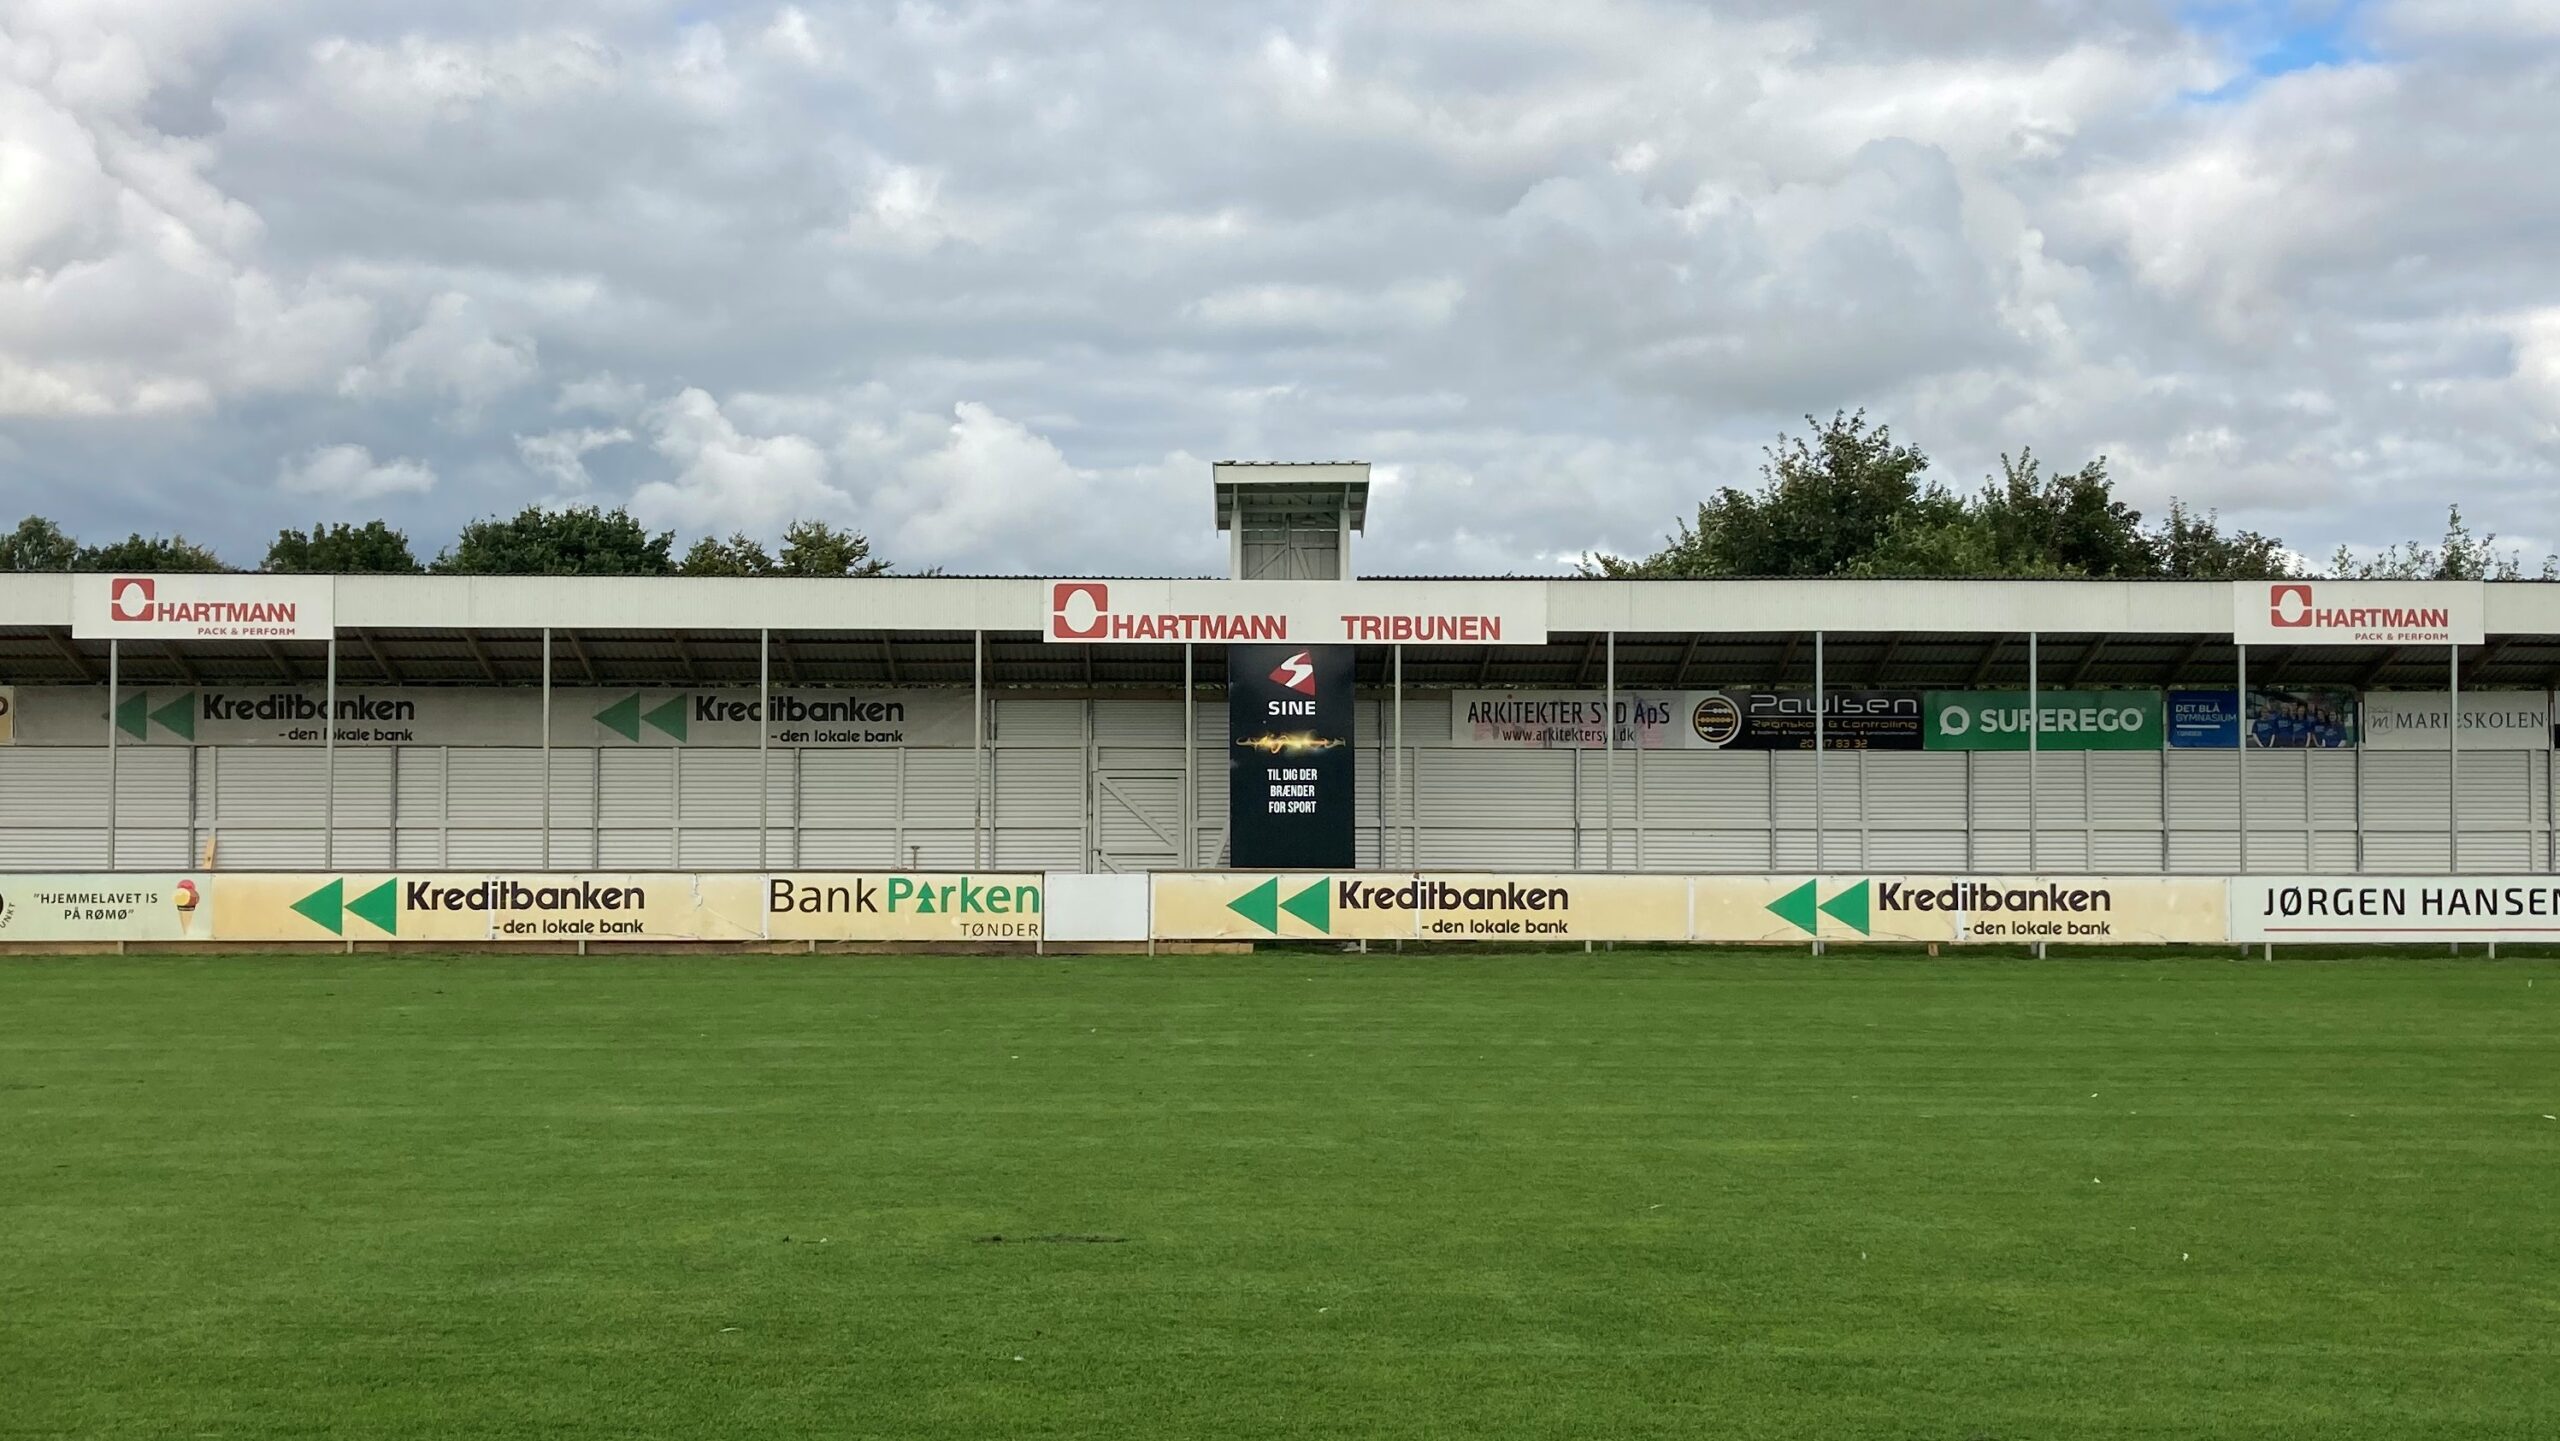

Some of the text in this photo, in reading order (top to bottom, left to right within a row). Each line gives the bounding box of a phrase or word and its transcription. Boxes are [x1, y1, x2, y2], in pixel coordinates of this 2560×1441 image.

[157, 602, 296, 623] HARTMANN
[2315, 608, 2449, 628] HARTMANN
[198, 627, 296, 636] PACK & PERFORM
[1112, 614, 1501, 641] HARTMANN TRIBUNEN
[2355, 632, 2449, 641] PACK & PERFORM
[203, 693, 415, 720] Kreditbanken
[1268, 700, 1316, 716] SINE
[1750, 694, 1918, 714] Paulsen
[2175, 701, 2221, 713] DET BLÅ
[1467, 700, 1583, 724] ARKITEKTER
[1633, 701, 1670, 730] ApS
[1979, 707, 2144, 733] SUPEREGO
[2175, 713, 2237, 722] GYMNASIUM
[2395, 711, 2544, 729] MARISKOLEN
[1751, 719, 1817, 729] Regnska
[1841, 720, 1918, 730] Controlling
[374, 727, 413, 741] bank
[814, 729, 860, 743] lokale
[864, 729, 903, 743] bank
[1835, 738, 1851, 749] 83
[1853, 738, 1868, 749] 32
[1267, 768, 1318, 781] TIL DIG DER
[1269, 784, 1316, 797] BRÆNDER
[1268, 801, 1317, 814] FOR SPORT
[145, 892, 158, 904] IS
[406, 880, 646, 911] Kreditbanken
[769, 877, 878, 914] Bank
[1339, 880, 1569, 910] Kreditbanken
[1878, 882, 2112, 912] Kreditbanken
[2263, 886, 2407, 917] JØRGEN
[63, 908, 81, 921] PÅ
[542, 919, 595, 934] lokale
[600, 919, 644, 934] bank
[959, 922, 1039, 937] TØNDER
[1470, 919, 1521, 934] lokale
[1525, 919, 1568, 934] bank
[2011, 920, 2062, 935] lokale
[2067, 920, 2111, 935] bank
